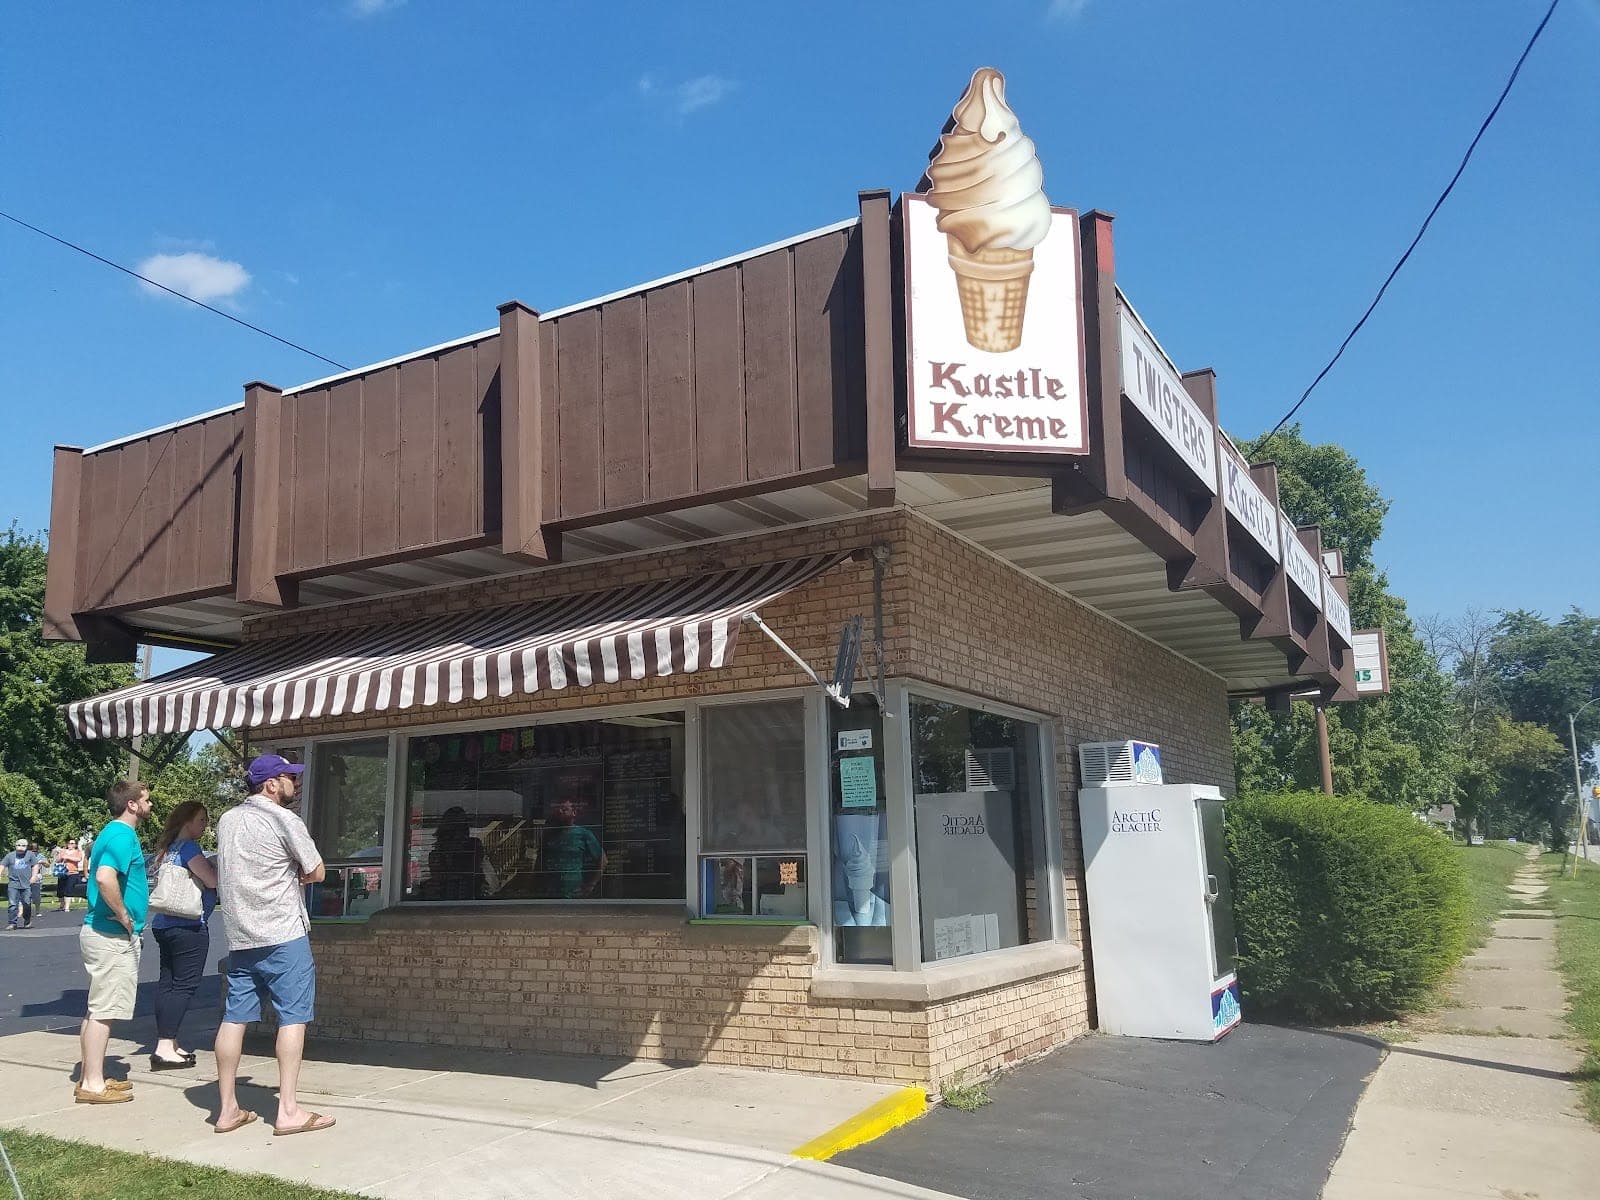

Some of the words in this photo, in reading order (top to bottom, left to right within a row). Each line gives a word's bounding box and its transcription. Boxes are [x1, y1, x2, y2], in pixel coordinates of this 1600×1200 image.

[929, 360, 1067, 401] Kastle
[929, 401, 1068, 440] Kreme
[1132, 342, 1207, 469] TWISTERS
[1226, 456, 1273, 547] Kastle
[1112, 809, 1161, 823] ARCTIC
[1112, 823, 1162, 832] GLACIER
